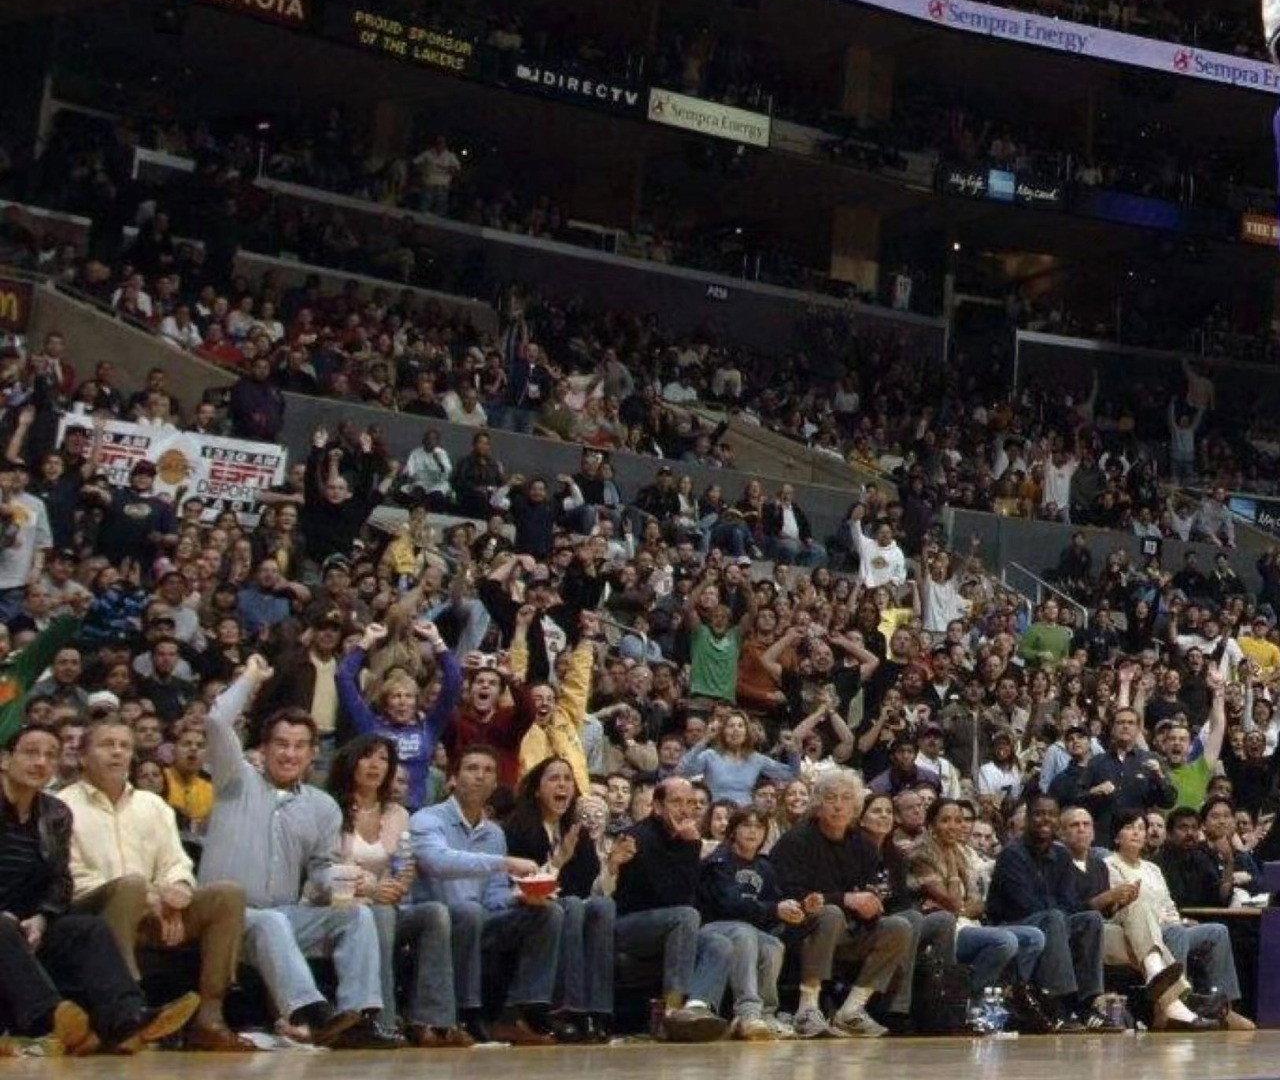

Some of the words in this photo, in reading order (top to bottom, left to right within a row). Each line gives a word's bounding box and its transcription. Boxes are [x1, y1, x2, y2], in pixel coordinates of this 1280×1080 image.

[948, 3, 1018, 36] Sempra
[1024, 21, 1088, 51] Energy
[1194, 53, 1258, 84] Sempra
[543, 71, 638, 105] DIRECTV
